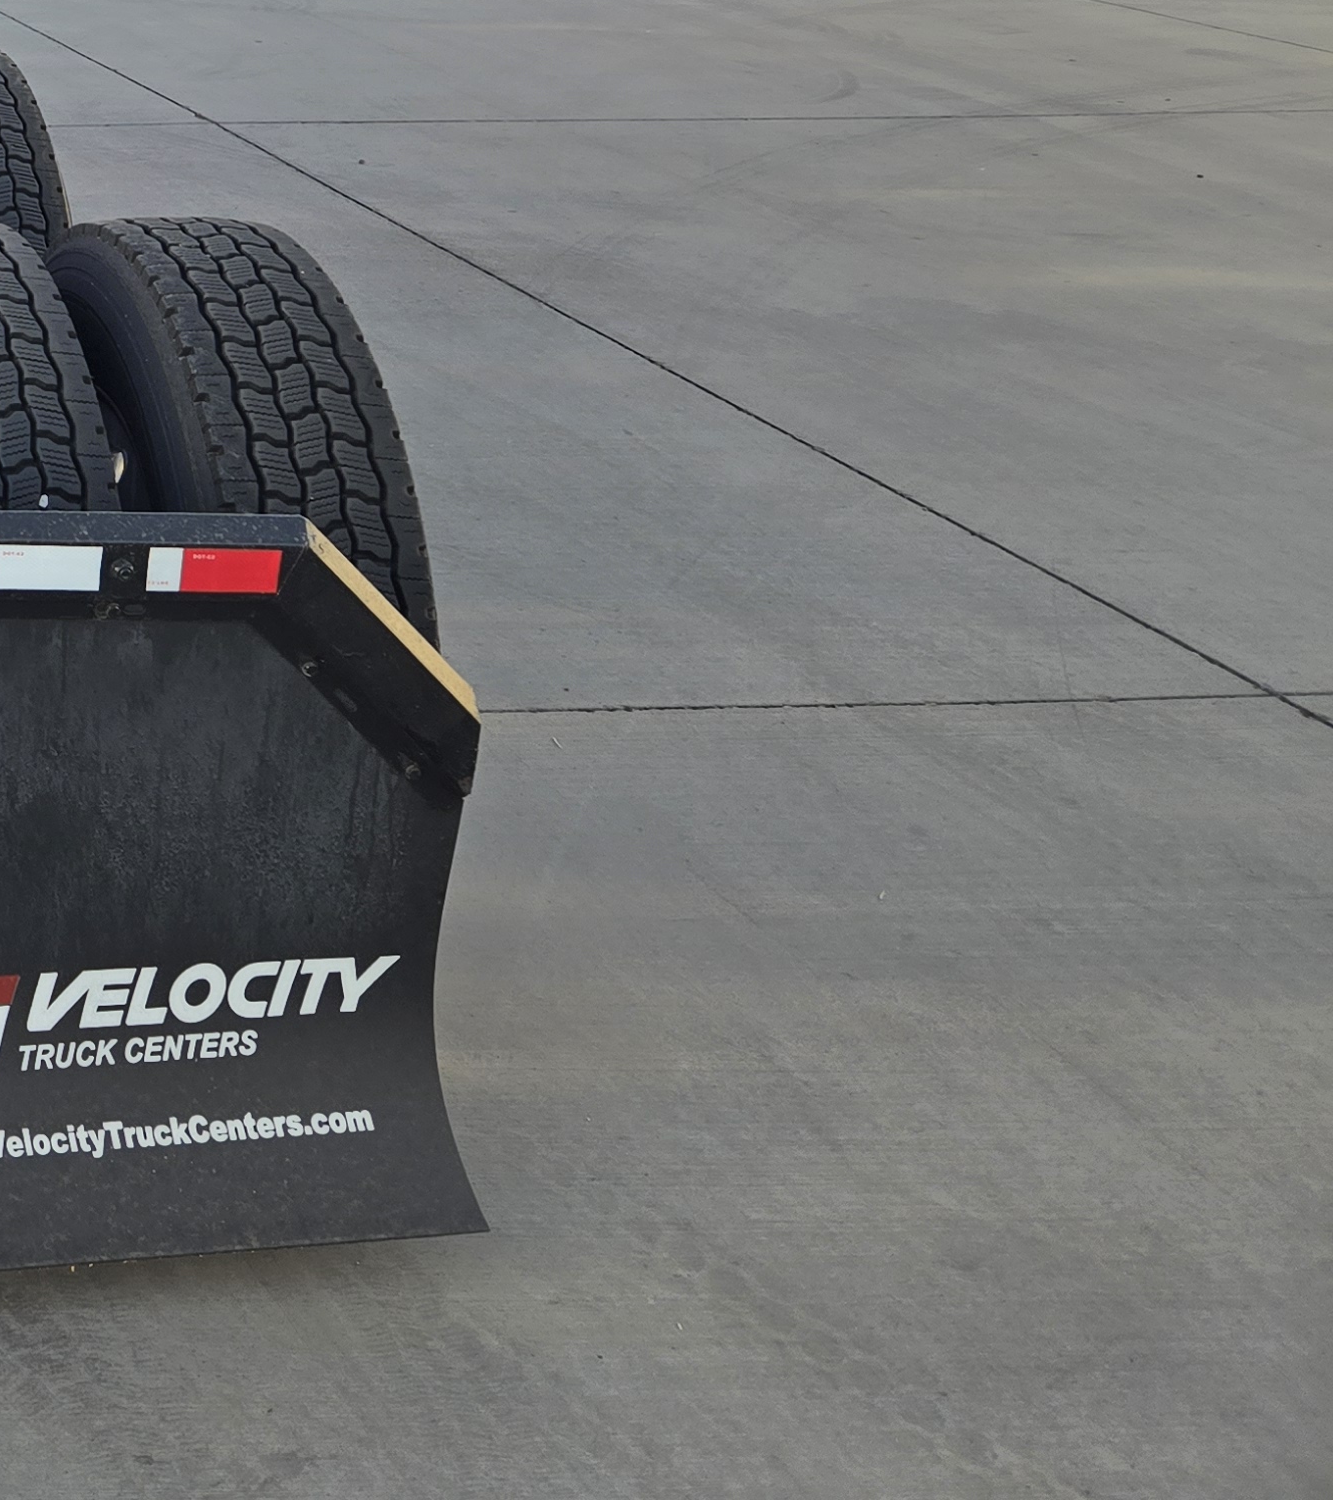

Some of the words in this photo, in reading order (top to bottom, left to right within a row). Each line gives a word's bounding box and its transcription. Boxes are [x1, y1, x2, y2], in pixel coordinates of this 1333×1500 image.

[26, 955, 401, 1032] VELOCITY
[19, 1038, 118, 1071] TRUCK
[124, 1030, 259, 1064] CENTERS
